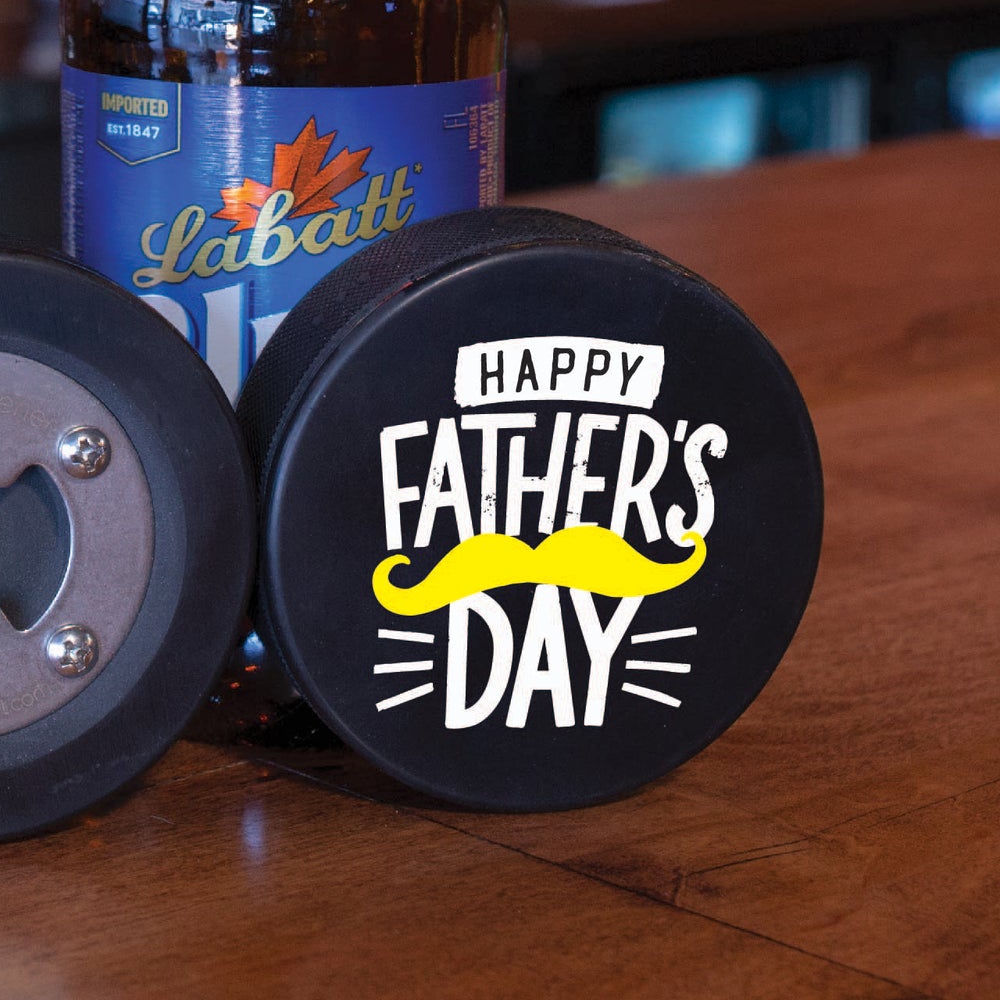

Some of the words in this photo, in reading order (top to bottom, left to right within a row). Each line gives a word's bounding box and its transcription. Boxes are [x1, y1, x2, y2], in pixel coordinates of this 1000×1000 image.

[102, 92, 169, 118] IMPORTED
[480, 347, 644, 396] HAPPY
[379, 412, 729, 551] FATHER'S
[445, 584, 645, 729] DAY
